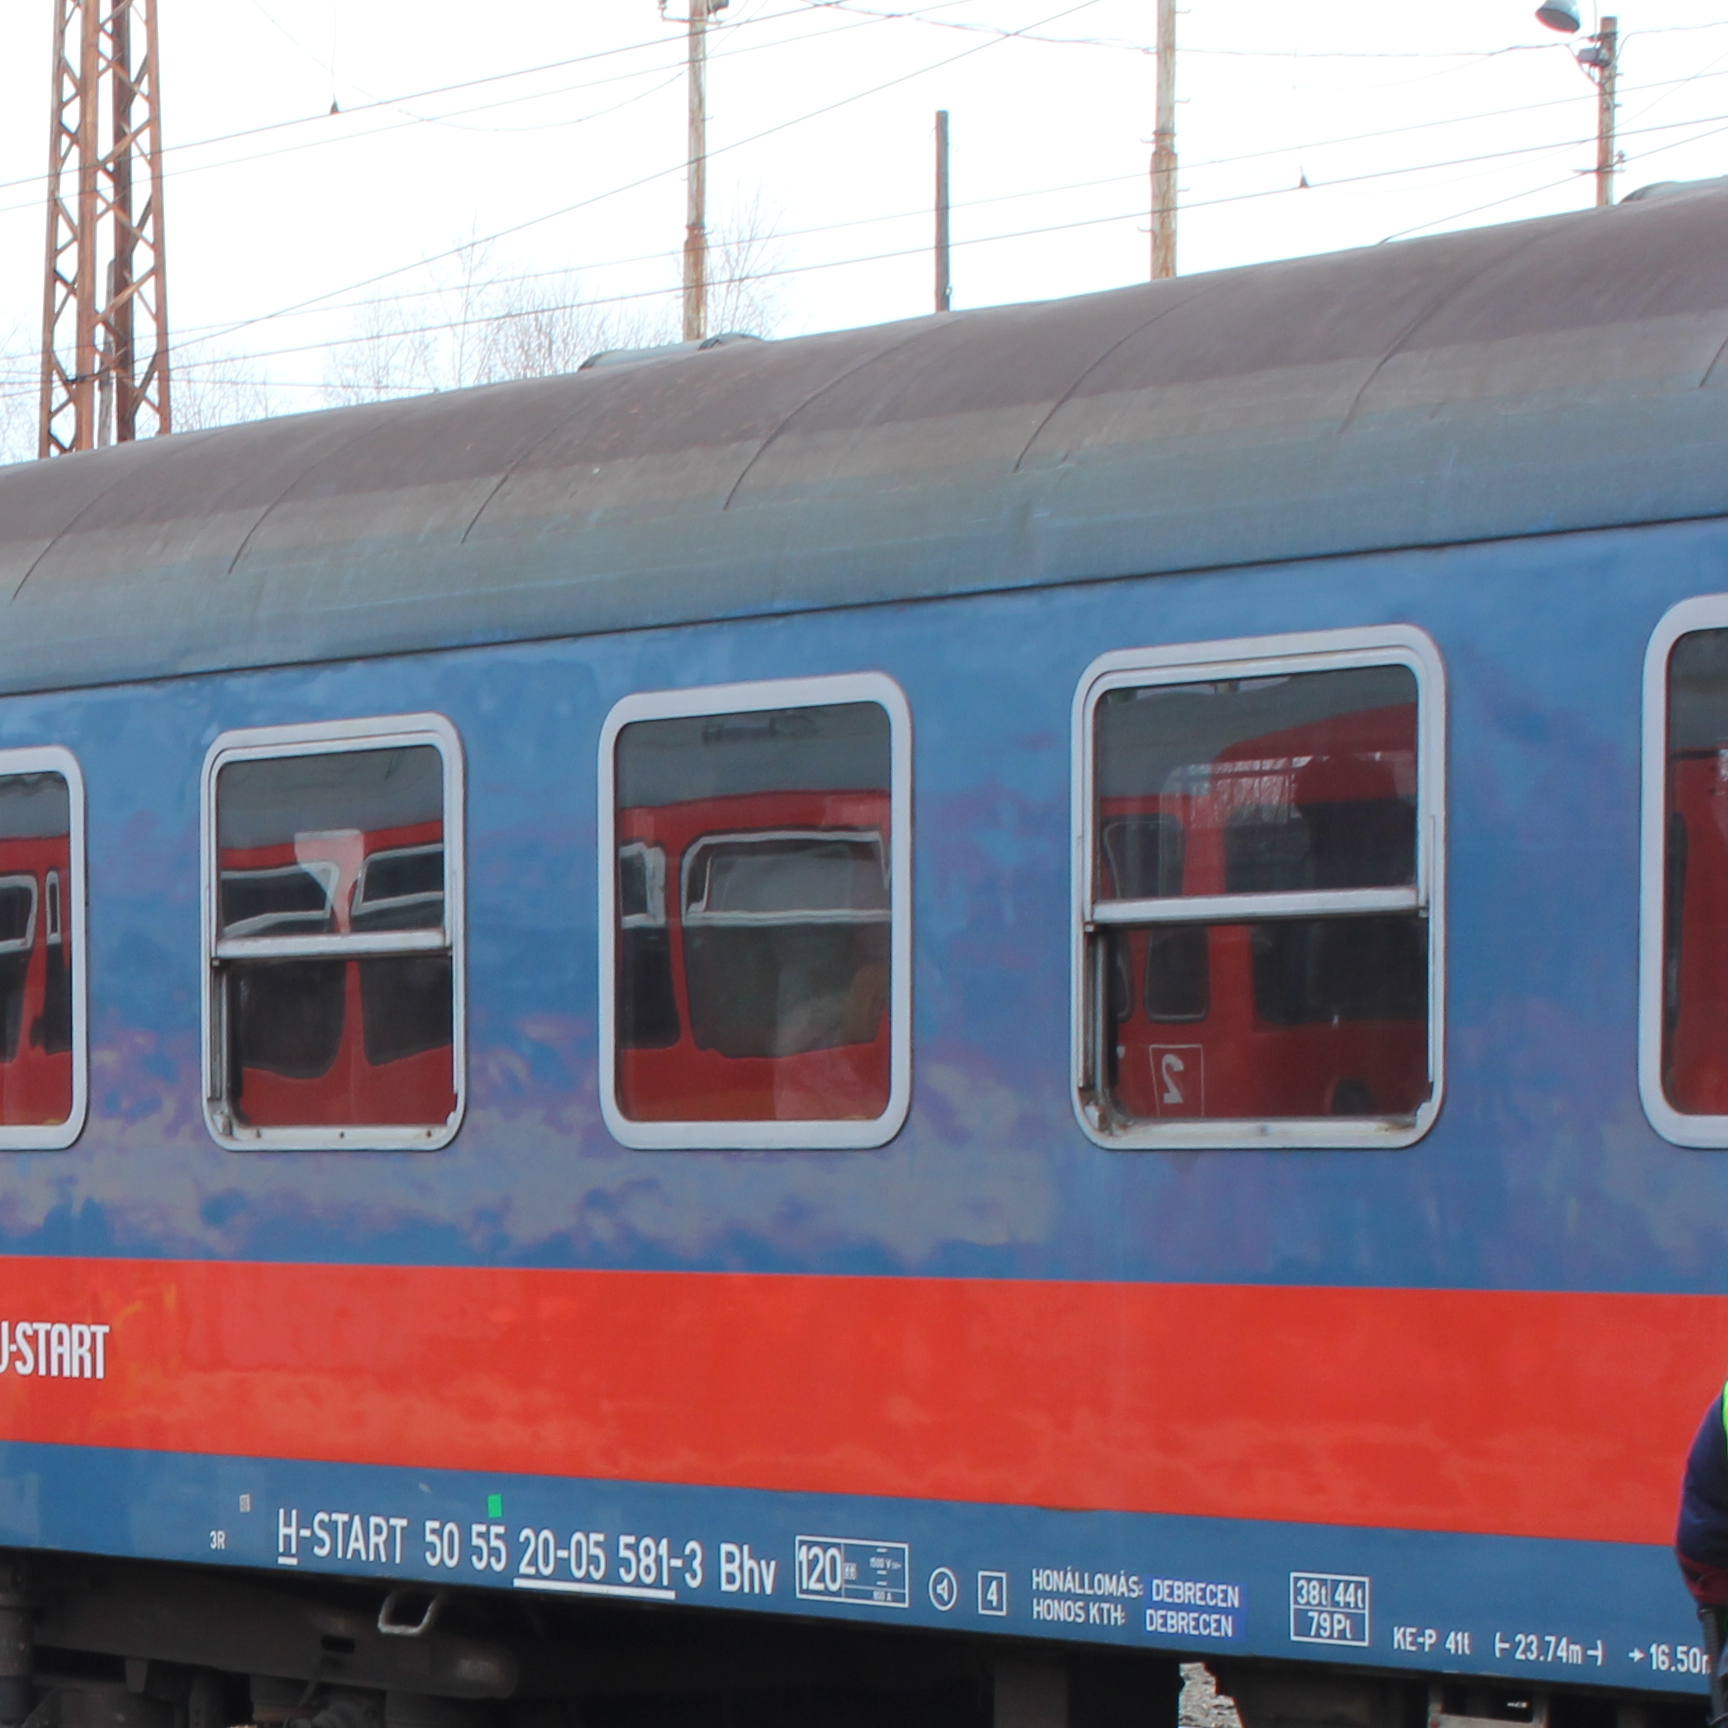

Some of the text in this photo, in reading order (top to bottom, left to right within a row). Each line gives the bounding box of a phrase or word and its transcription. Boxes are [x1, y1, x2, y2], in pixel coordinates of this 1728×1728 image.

[209, 1529, 226, 1550] 3R
[277, 1507, 777, 1596] H-START 50 55 20-05 581-3 Bhv
[798, 1544, 842, 1593] 120
[986, 1579, 999, 1608] 4
[1151, 1578, 1241, 1609] DEBRECEN
[1032, 1598, 1086, 1624] HONOS
[1145, 1609, 1234, 1638] DEBRECEN
[1393, 1626, 1437, 1653] KE-P
